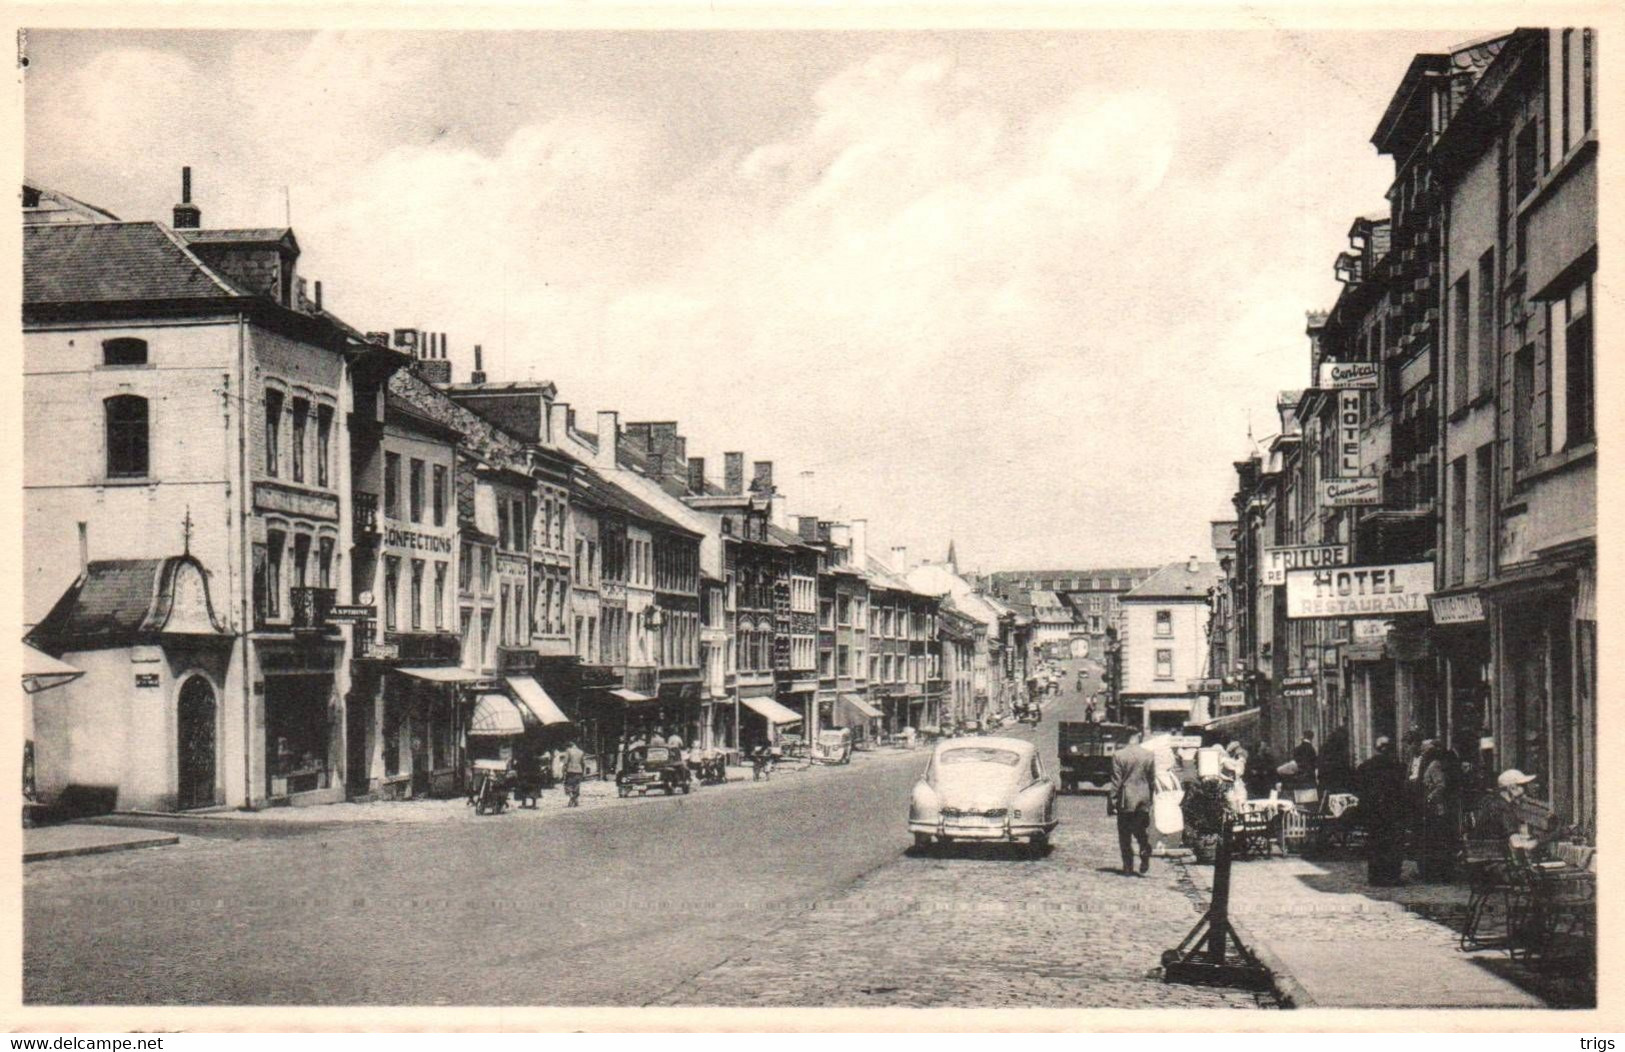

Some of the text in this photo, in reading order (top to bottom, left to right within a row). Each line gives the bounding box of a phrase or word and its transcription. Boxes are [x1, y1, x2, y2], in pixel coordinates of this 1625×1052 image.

[1331, 364, 1377, 381] Central
[1343, 397, 1358, 469] HOTEL
[1272, 547, 1344, 568] FRITURE
[1313, 568, 1404, 598] HOTEL
